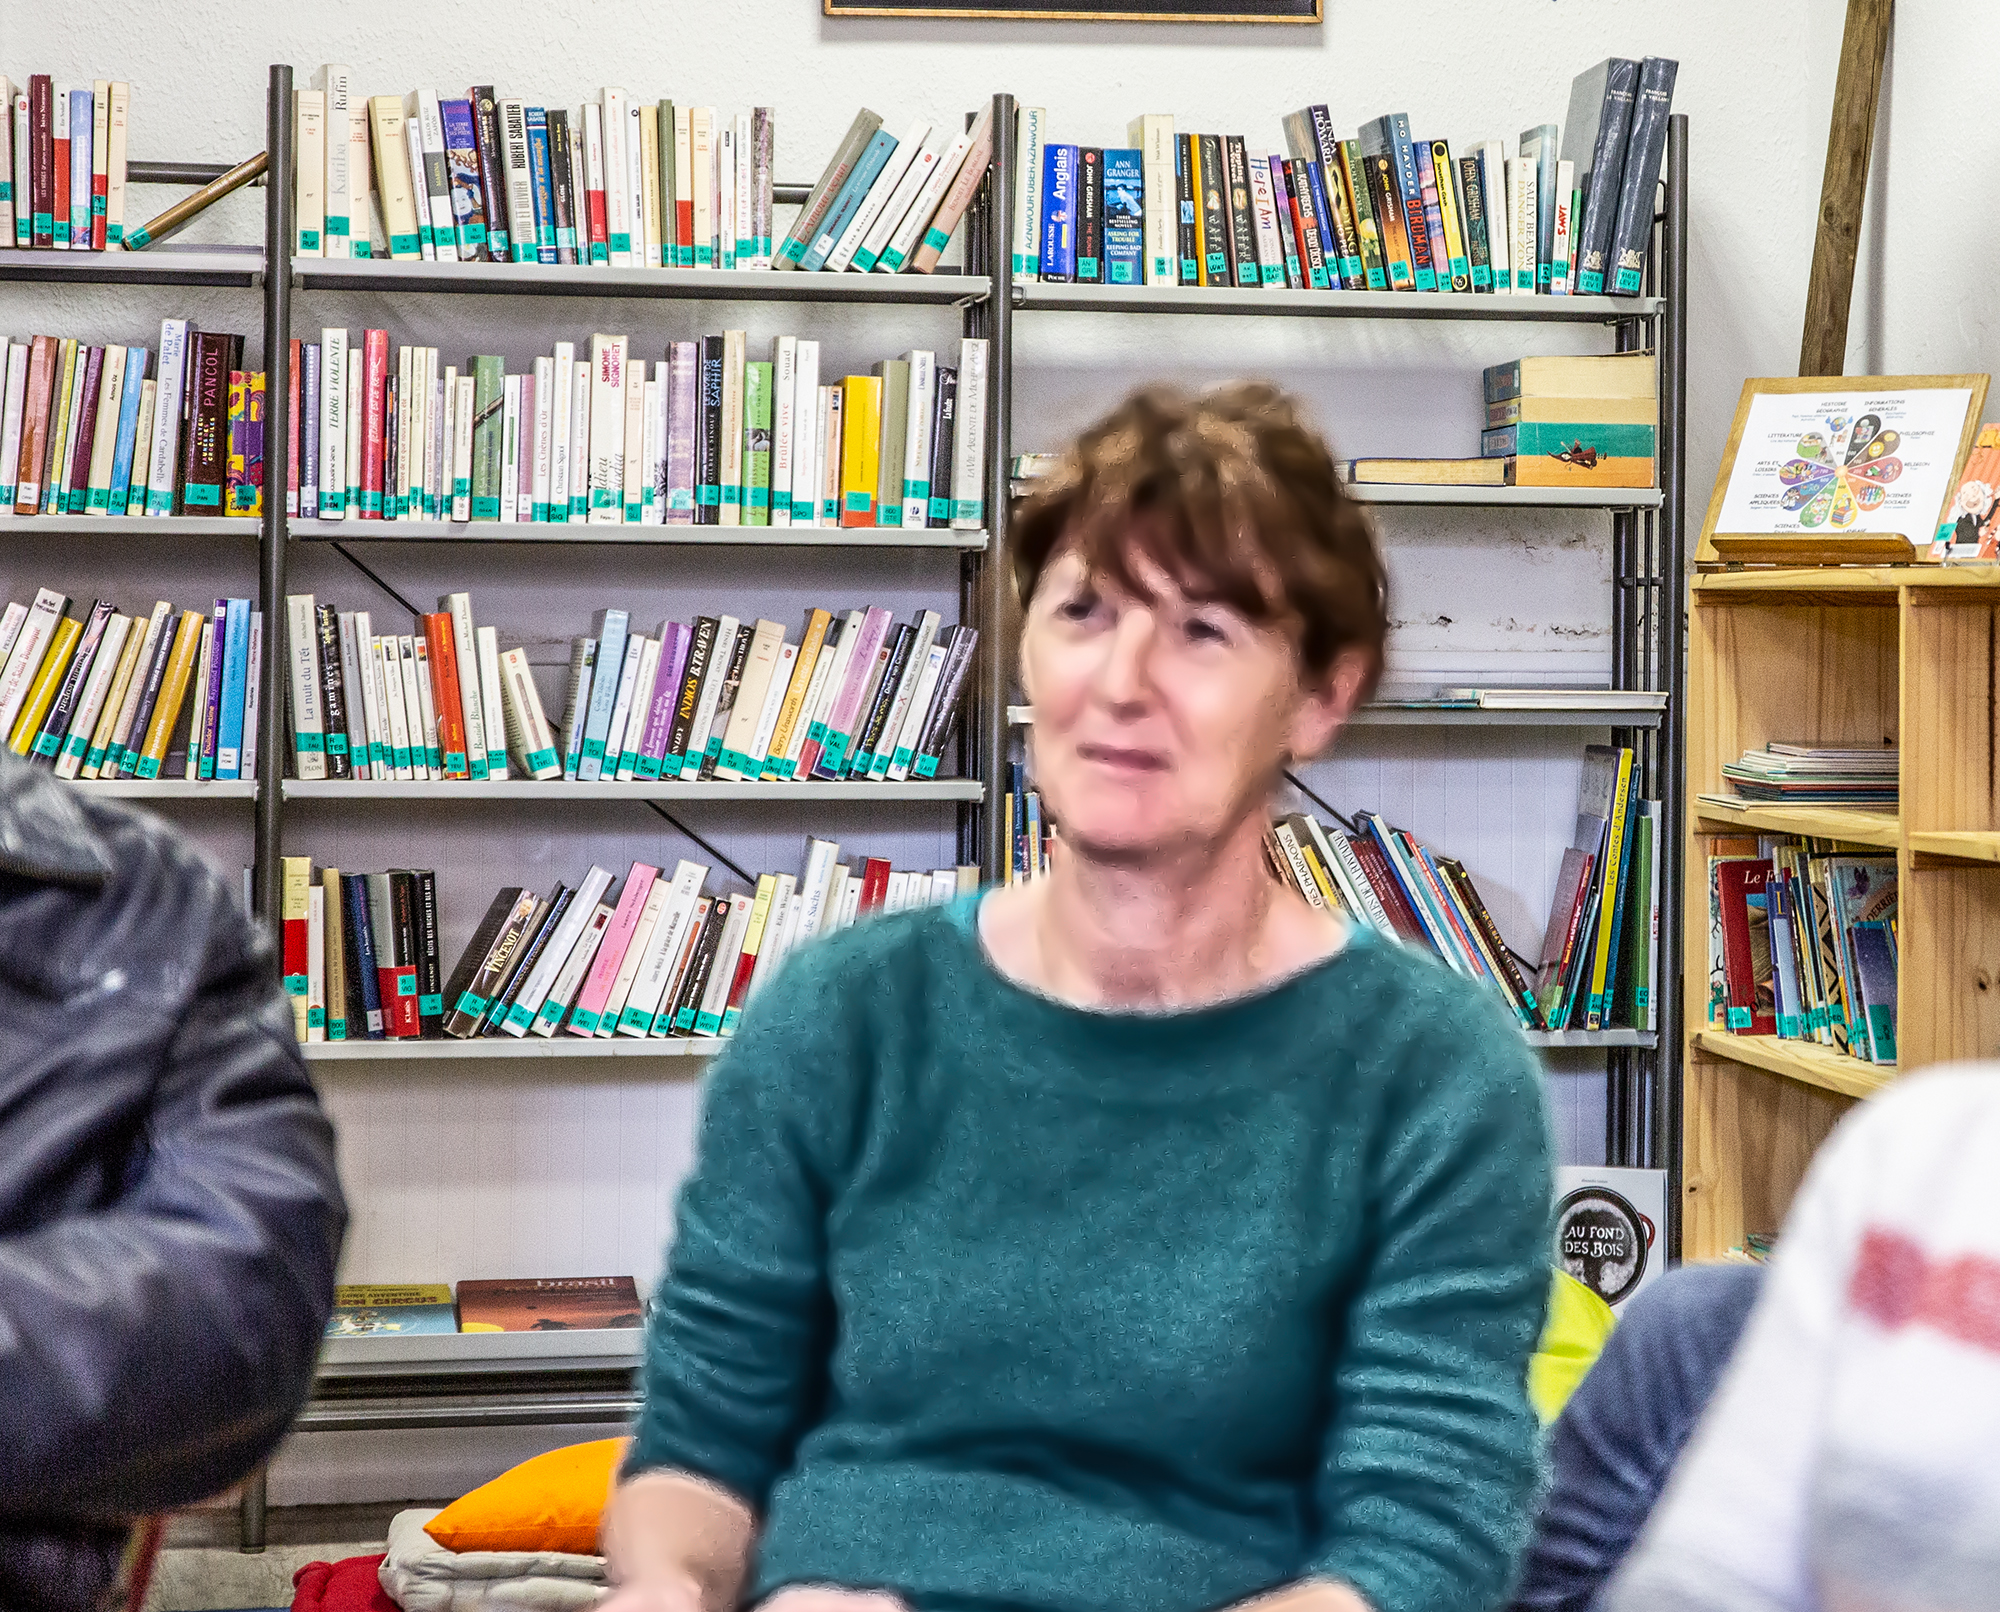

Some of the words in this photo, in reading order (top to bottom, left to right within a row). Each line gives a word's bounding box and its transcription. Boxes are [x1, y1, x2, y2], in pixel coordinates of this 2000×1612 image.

[335, 75, 348, 111] Rufin
[505, 103, 524, 139] SABATIER
[1397, 119, 1407, 138] MO
[1027, 110, 1038, 165] AZNAVOUR
[1313, 110, 1333, 165] HOWARD
[1324, 119, 1338, 154] LINDA
[331, 143, 347, 195] Katiba
[509, 141, 526, 169] ROBERT
[1115, 160, 1131, 169] ANN
[1234, 142, 1244, 184] Tipping
[1401, 144, 1416, 195] HAYDER
[1052, 147, 1070, 201] Anglais
[1086, 164, 1094, 185] JOHN
[1106, 167, 1140, 178] GRANGER
[1249, 158, 1269, 196] Here
[1381, 173, 1391, 191] JOHN
[1435, 162, 1446, 191] Jonathan
[1462, 159, 1476, 182] JOHN
[1086, 185, 1094, 218] GRISHAM
[1255, 196, 1270, 206] I
[1384, 192, 1396, 222] GRISHAM
[1465, 184, 1480, 221] GRISHAM
[1516, 180, 1526, 236] DANGER
[1526, 180, 1535, 220] SALLY
[1024, 195, 1035, 249] AZNAVOUR
[1258, 207, 1273, 230] Am
[1341, 206, 1357, 254] DYING
[1406, 199, 1429, 266] BIRDMAN
[1557, 204, 1568, 236] JAWS
[1046, 223, 1055, 267] LAROUSSE
[1526, 222, 1535, 271] BEAUMA
[164, 323, 174, 337] de
[161, 339, 173, 366] Palet
[172, 333, 182, 357] Marie
[203, 348, 219, 407] PANCOL
[328, 337, 340, 391] VIOLENTE
[601, 347, 611, 383] SIMONE
[611, 342, 621, 388] SIGNORET
[782, 349, 791, 381] Souad
[108, 383, 117, 401] Amos
[164, 377, 173, 391] Les
[710, 357, 722, 407] SAPHIR
[160, 392, 172, 427] Femmes
[328, 394, 340, 430] TERRE
[538, 409, 548, 428] d'Or
[781, 402, 789, 427] vive
[967, 402, 977, 414] DE
[159, 428, 168, 437] de
[966, 415, 977, 453] ARDENTE
[155, 438, 168, 484] Cardabelle
[400, 443, 408, 455] que
[557, 445, 566, 465] Signol
[778, 431, 789, 469] Brûlée
[966, 455, 976, 469] VIE
[400, 463, 406, 471] de
[537, 463, 547, 477] Les
[706, 447, 716, 482] GILBERT
[555, 465, 565, 495] Christian
[689, 618, 712, 677] B.TRAVEN
[894, 630, 911, 665] Cauwelaert
[913, 623, 932, 660] Cauwelaert
[300, 667, 311, 681] du
[890, 664, 899, 676] van
[909, 658, 919, 672] van
[301, 683, 313, 705] nuit
[325, 664, 341, 717] gamines
[791, 677, 805, 694] Un
[882, 675, 895, 695] Didier
[902, 671, 915, 691] Didier
[470, 690, 480, 721] Blanche
[679, 675, 698, 720] INDIOS
[892, 704, 903, 720] sous
[897, 694, 907, 706] X
[206, 704, 215, 727] intime
[303, 707, 315, 721] La
[778, 696, 799, 734] Unsworth
[204, 728, 213, 755] Poulidor
[329, 743, 344, 751] TES
[472, 721, 484, 750] Bastide
[772, 733, 787, 756] Barry
[880, 720, 898, 753] Rencontre
[304, 764, 322, 772] PLON
[641, 766, 656, 774] TOW
[1611, 775, 1630, 831] d'Andersen
[1279, 832, 1315, 888] PHARAONS
[1332, 832, 1361, 875] FONTAINE
[1608, 833, 1622, 866] Contes
[1353, 872, 1367, 887] LA
[1605, 868, 1616, 886] Les
[1744, 870, 1761, 884] Le
[424, 891, 432, 901] DES
[774, 910, 784, 926] Elie
[779, 883, 791, 909] Wiesel
[806, 888, 821, 917] Sachs
[1306, 887, 1322, 908] DES
[1360, 885, 1374, 899] DE
[620, 908, 632, 929] Lauren
[803, 918, 814, 931] de
[1366, 896, 1390, 930] FABLES
[425, 929, 434, 939] DES
[484, 924, 521, 976] VINCENOT
[630, 1018, 645, 1027] WEL
[1564, 1226, 1586, 1239] AU
[1589, 1226, 1625, 1240] FOND
[1564, 1241, 1589, 1254] DES
[1590, 1241, 1624, 1258] BOIS
